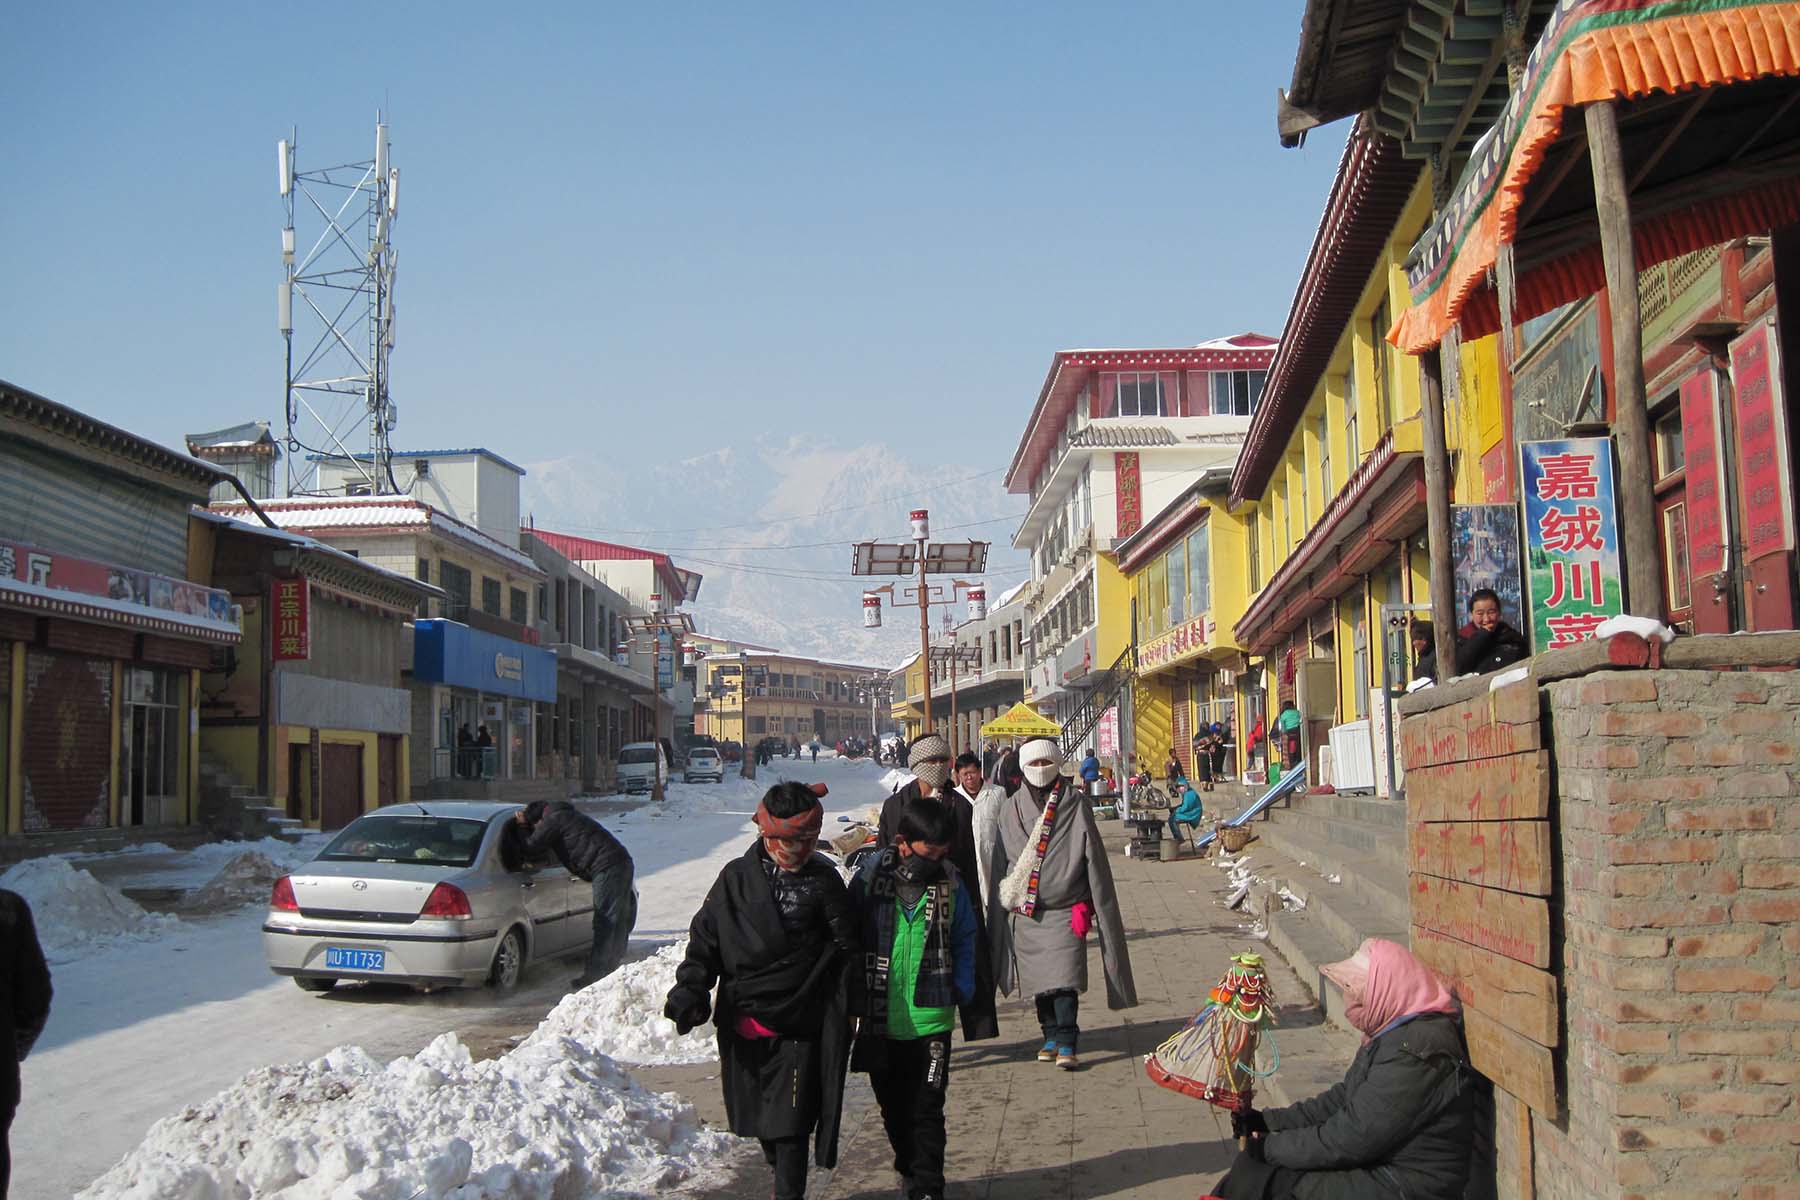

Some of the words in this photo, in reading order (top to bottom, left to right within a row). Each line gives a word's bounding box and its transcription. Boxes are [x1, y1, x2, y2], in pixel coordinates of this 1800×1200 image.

[1536, 453, 1610, 649] 嘉绒川菜
[280, 583, 300, 655] 正宗川菜
